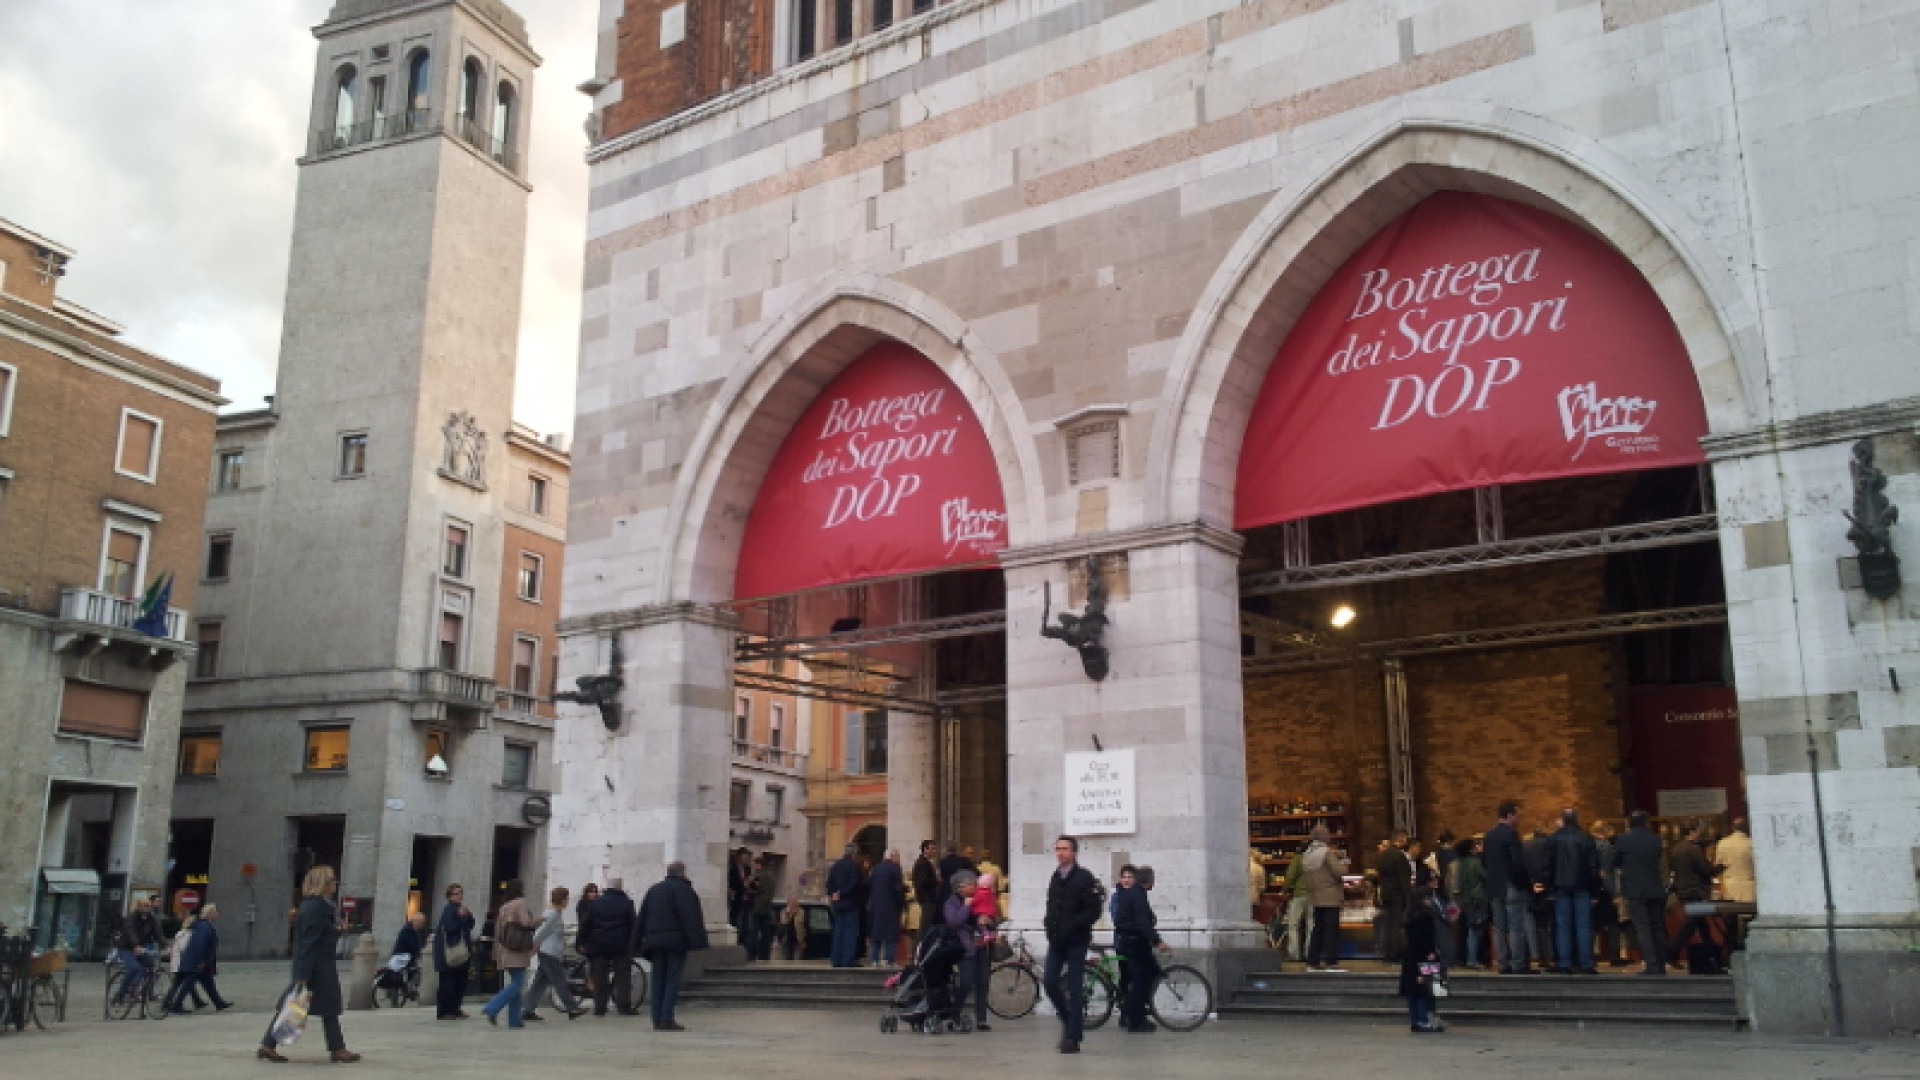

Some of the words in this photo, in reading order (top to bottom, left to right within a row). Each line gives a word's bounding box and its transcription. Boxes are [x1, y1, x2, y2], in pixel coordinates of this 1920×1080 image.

[1346, 247, 1541, 320] Bottega
[1327, 330, 1386, 375] dei
[1388, 281, 1573, 365] Sapori
[817, 388, 946, 440] Bottega
[1371, 356, 1521, 430] DOP
[802, 448, 841, 482] dei
[840, 415, 962, 478] Sapori
[822, 474, 922, 528] DOP
